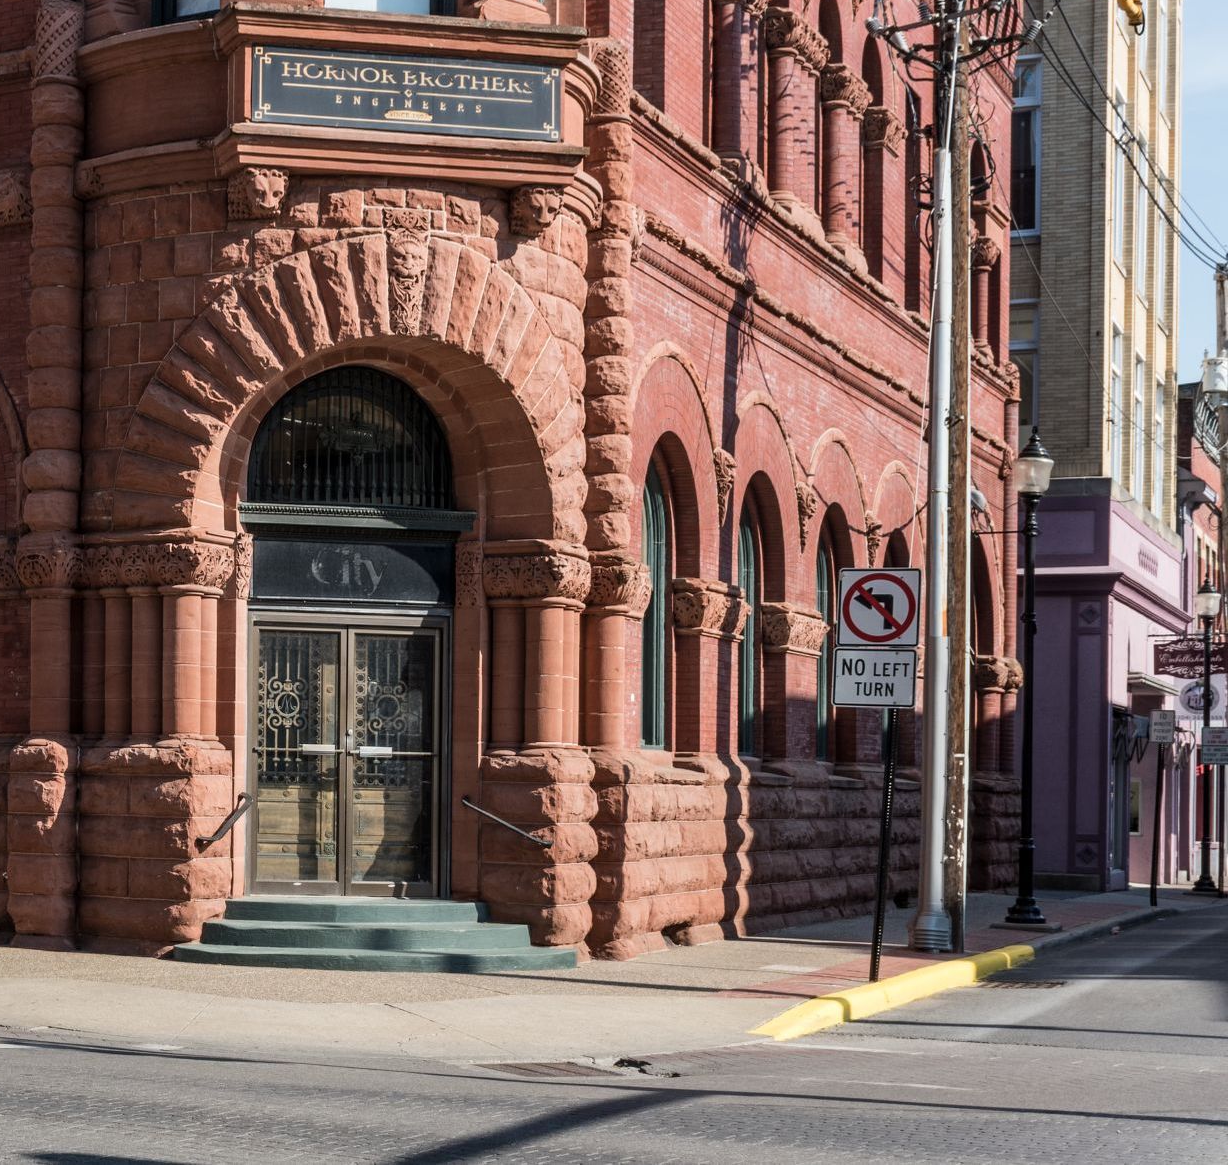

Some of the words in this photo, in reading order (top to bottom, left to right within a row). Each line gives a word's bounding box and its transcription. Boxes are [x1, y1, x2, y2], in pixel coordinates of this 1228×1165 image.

[281, 61, 397, 84] HORNOR
[402, 70, 533, 94] BROTHERS
[335, 94, 482, 114] ENGINEERS
[841, 658, 866, 676] NO
[873, 662, 910, 678] LEFT
[854, 681, 894, 697] TURN
